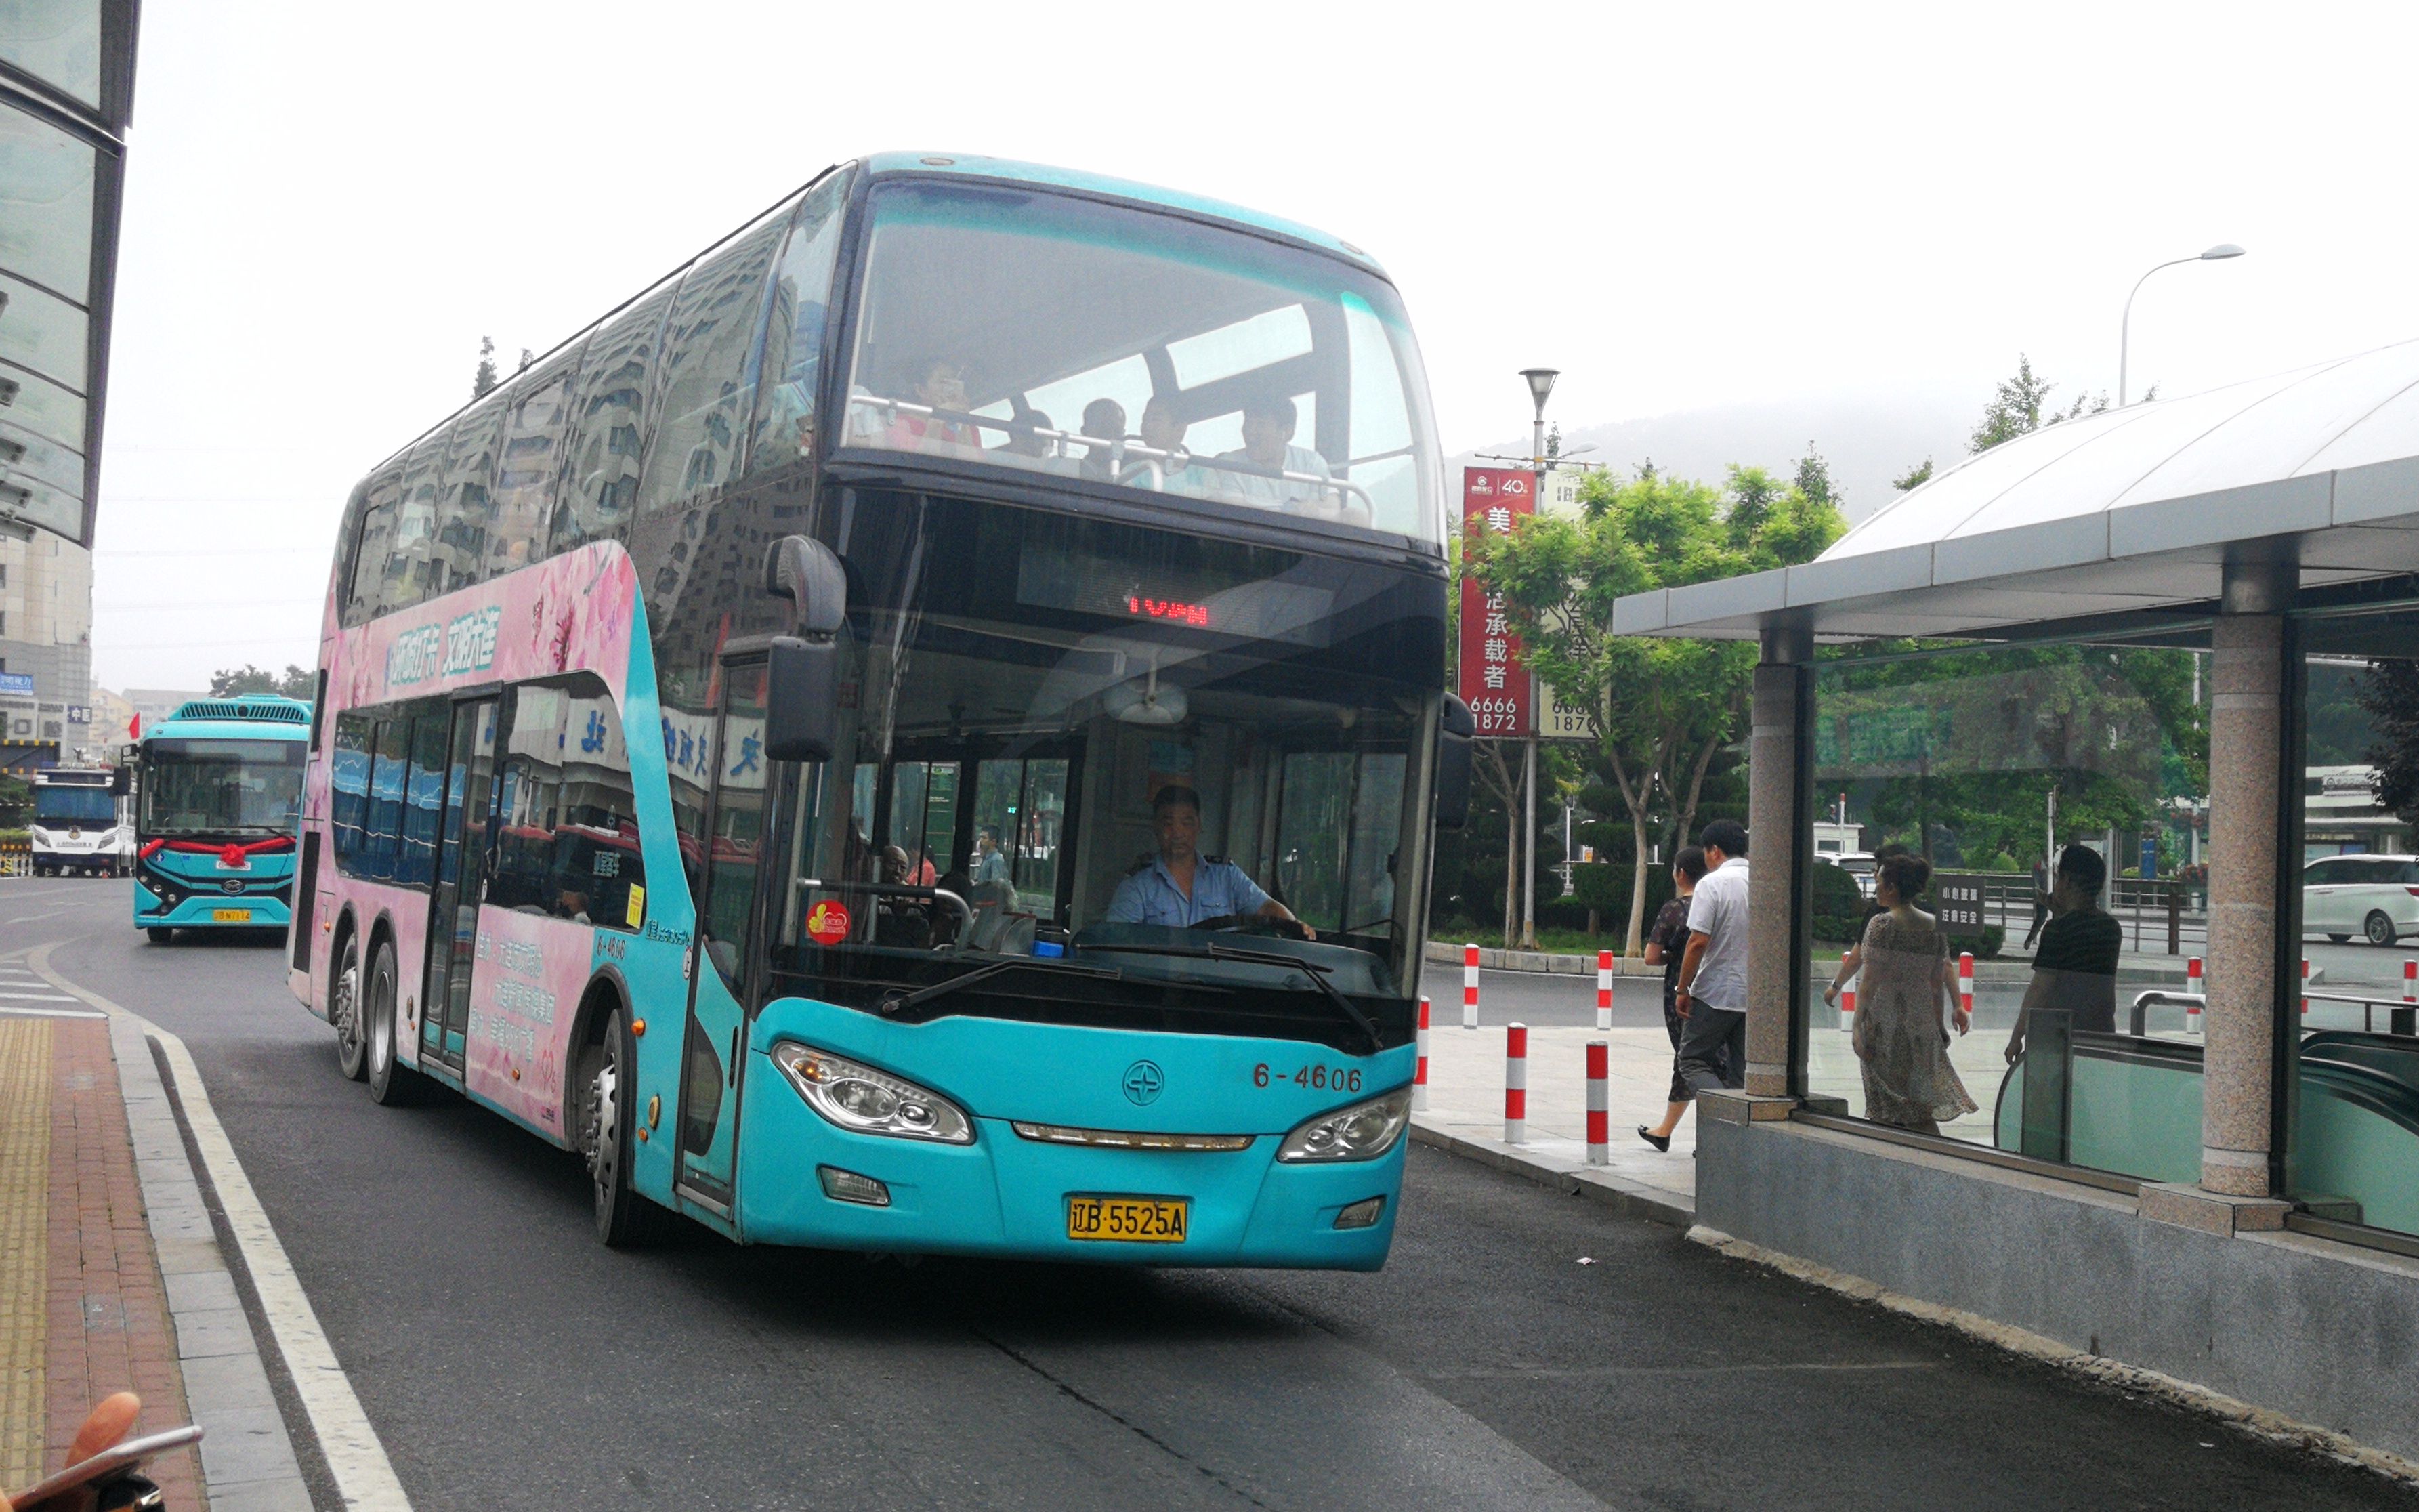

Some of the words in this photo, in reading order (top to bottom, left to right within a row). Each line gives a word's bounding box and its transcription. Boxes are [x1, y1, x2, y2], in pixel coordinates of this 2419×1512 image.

[1471, 696, 1516, 713] 6666
[1473, 714, 1515, 730] 1872
[1254, 1063, 1361, 1093] 6-4606
